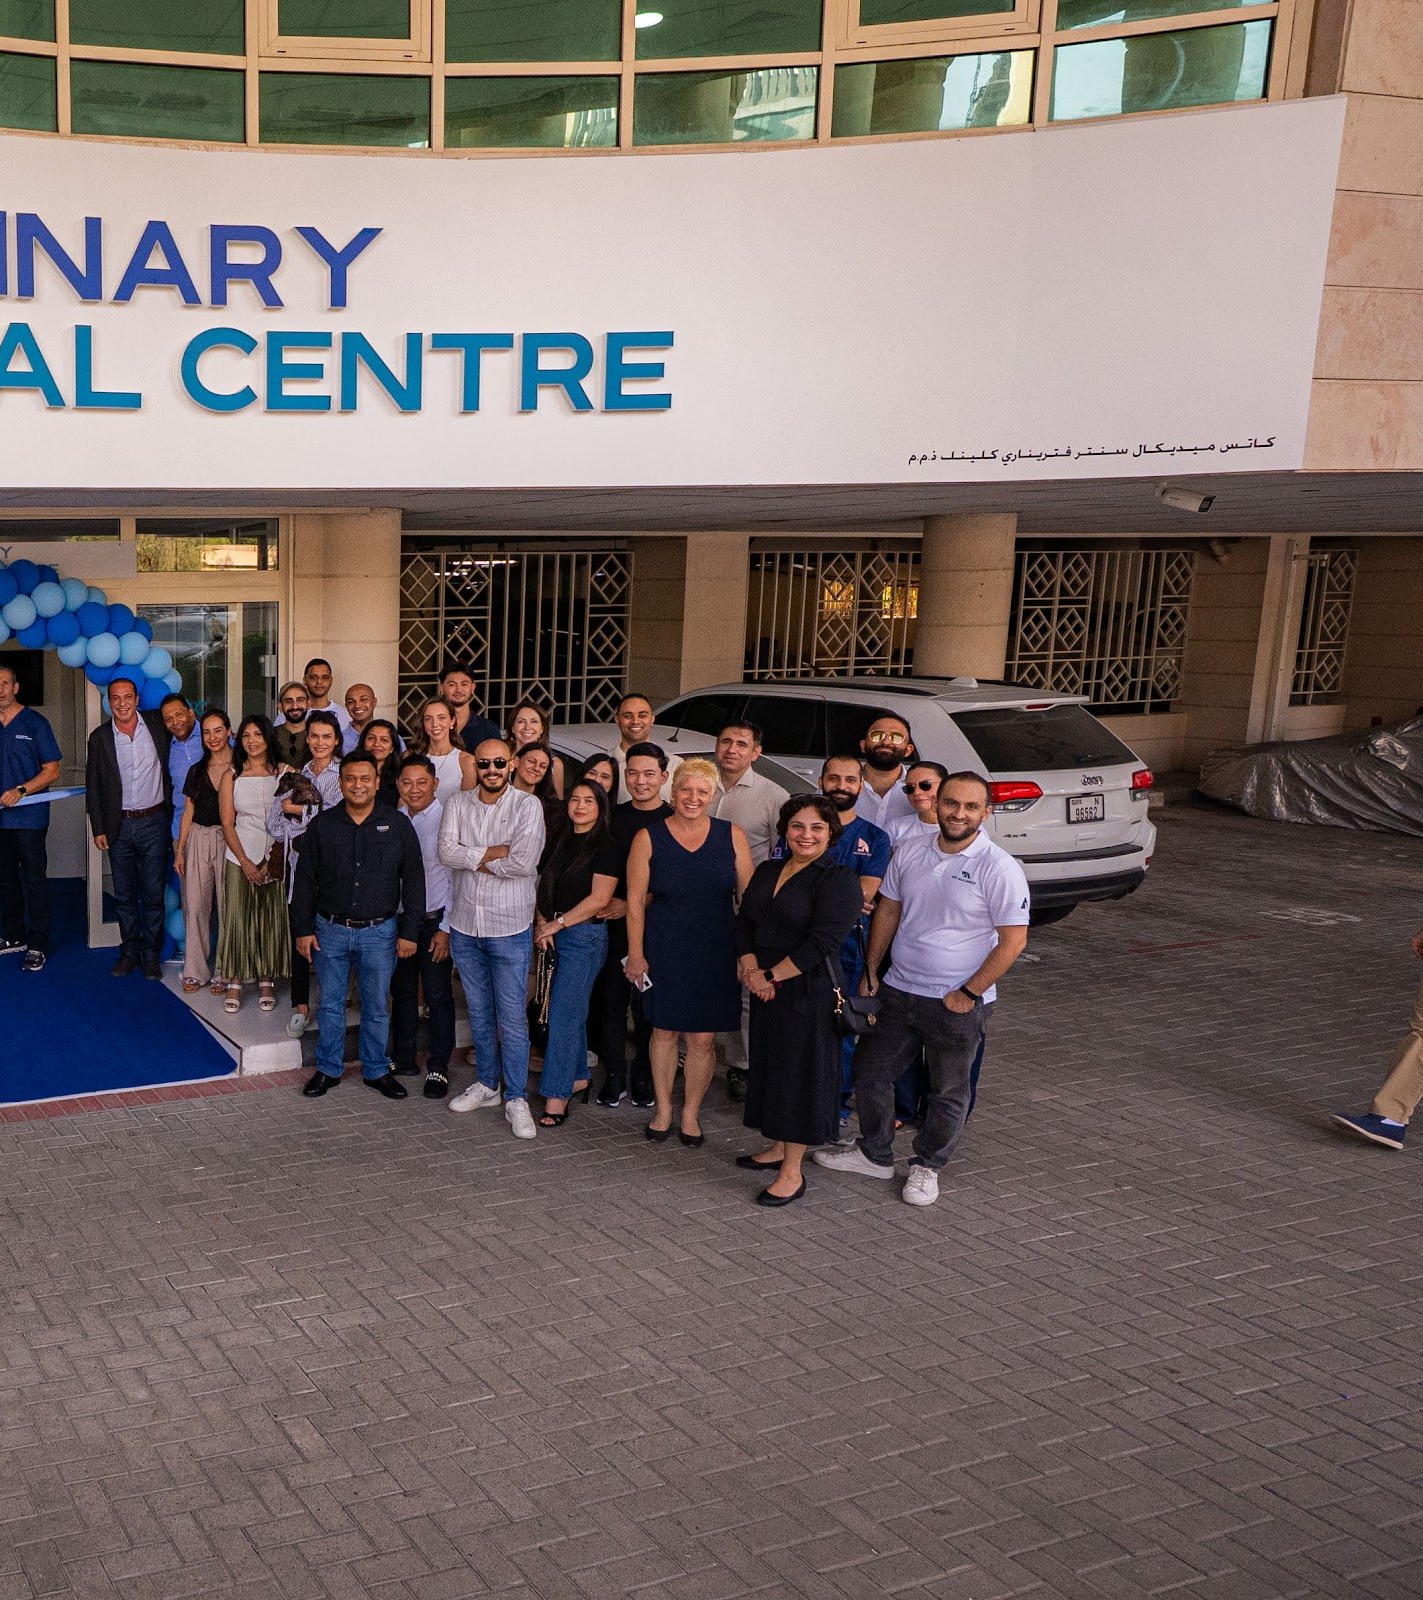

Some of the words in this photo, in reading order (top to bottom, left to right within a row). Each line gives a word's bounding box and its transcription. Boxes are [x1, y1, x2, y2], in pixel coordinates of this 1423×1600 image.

[180, 327, 675, 412] CENTRE
[1001, 446, 1072, 466] فتريناري
[1074, 446, 1128, 460] سنتر
[1132, 443, 1215, 458] ميديكال
[1081, 775, 1104, 787] Jeep
[1075, 806, 1098, 820] 96562
